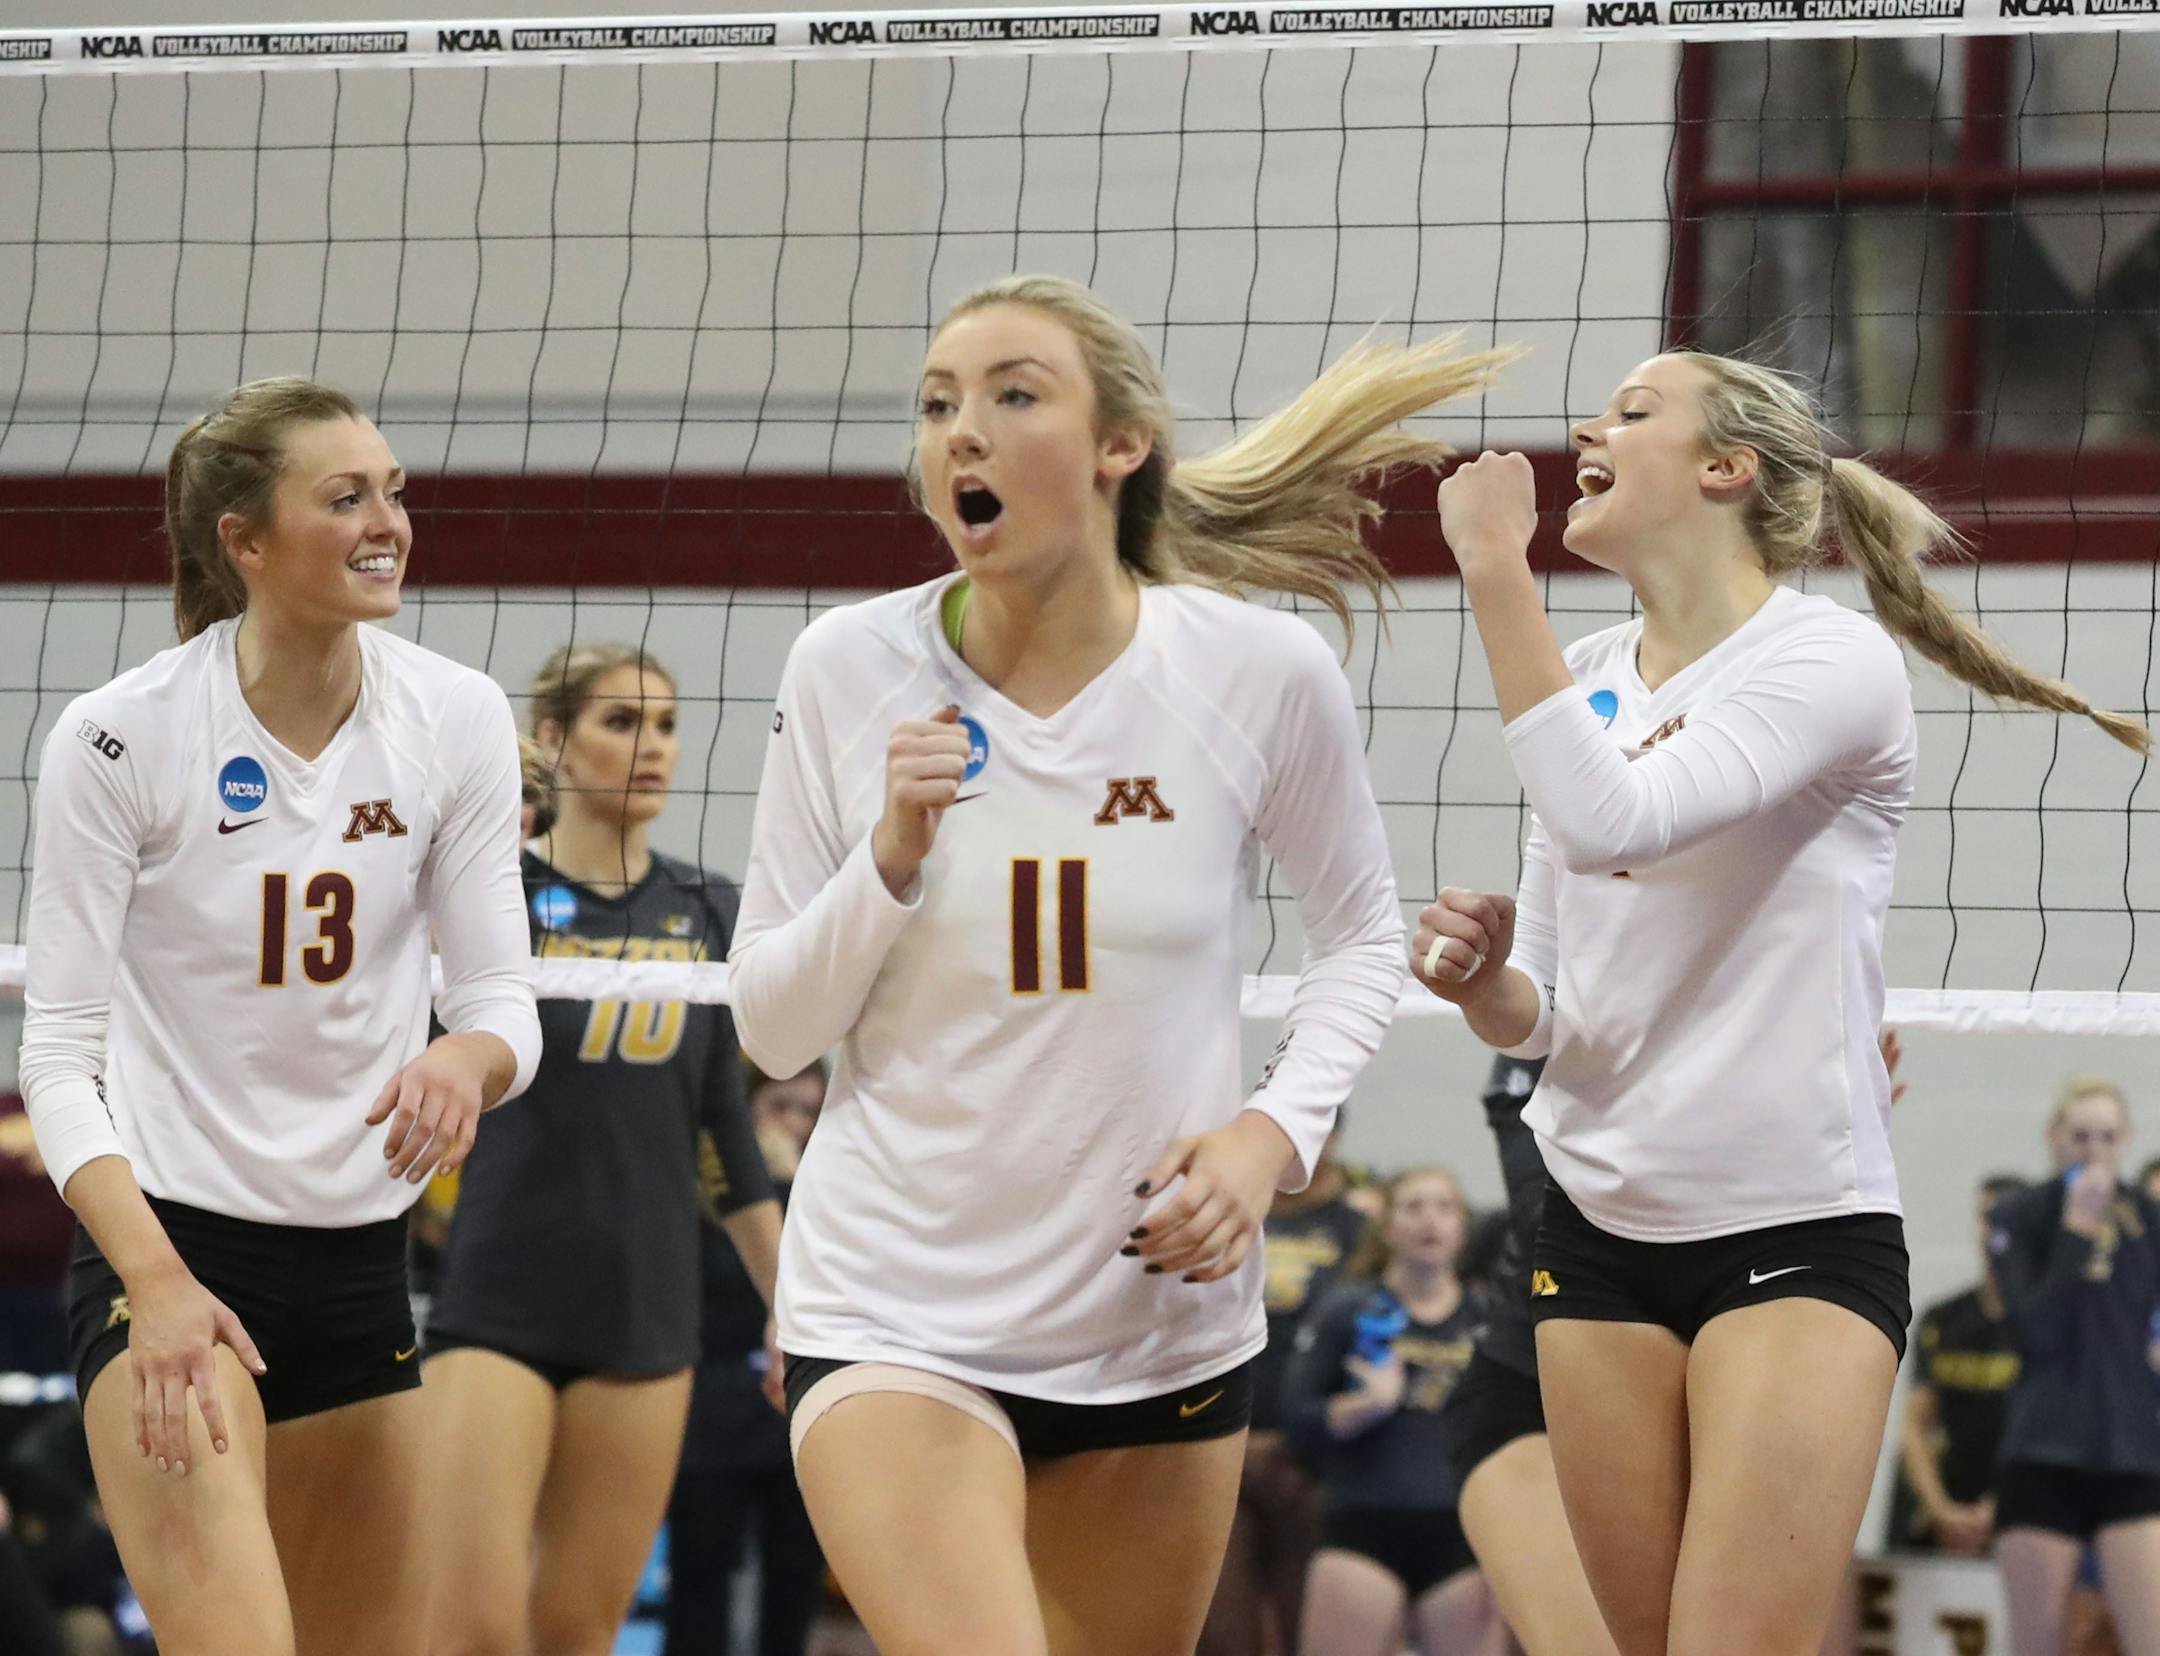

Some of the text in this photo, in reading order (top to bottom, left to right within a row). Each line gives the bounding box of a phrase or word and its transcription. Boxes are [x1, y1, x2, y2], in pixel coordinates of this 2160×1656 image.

[1191, 7, 1550, 35] NCAA VOLLEYBALL CHAMPIONSHIP
[1587, 0, 1961, 27] NCAA VOLLEYBALL CHAMPIONSHIP
[2000, 0, 2074, 16] NCAA
[438, 24, 774, 51] NCAA VOLLEYBALL CHAMPIONSHIP
[809, 16, 1158, 45] NCAA VOLLEYBALL CHAMPIONSHIP
[81, 33, 405, 58] NCAA VOLLEYBALL CHAMPIONSHIP
[224, 780, 264, 799] NCAA
[1094, 776, 1175, 826] M
[342, 798, 408, 843] M
[259, 869, 355, 988] 13
[1010, 856, 1091, 995] 11
